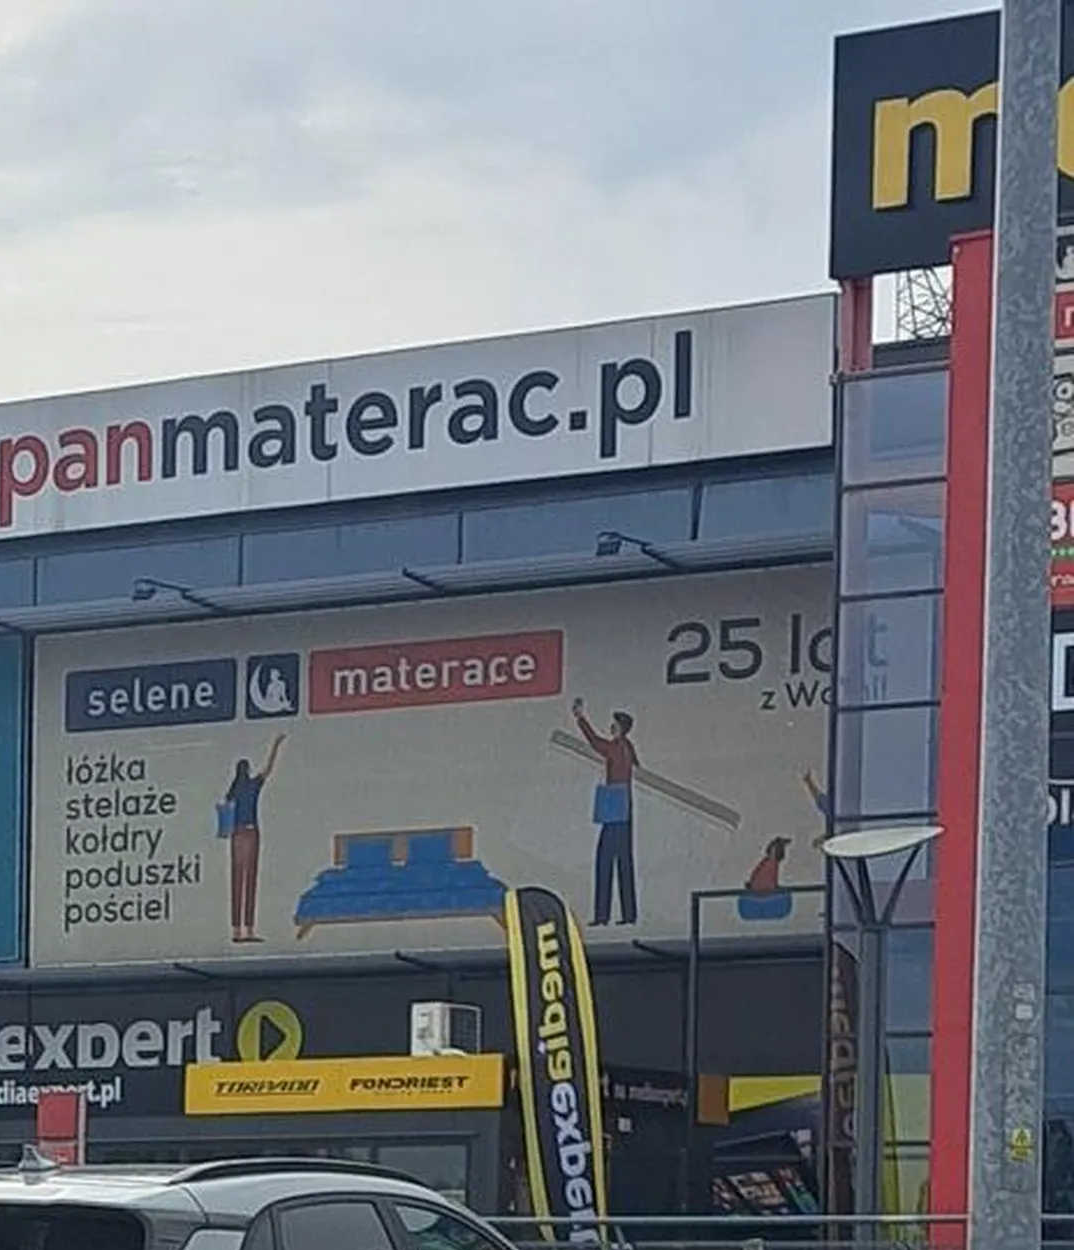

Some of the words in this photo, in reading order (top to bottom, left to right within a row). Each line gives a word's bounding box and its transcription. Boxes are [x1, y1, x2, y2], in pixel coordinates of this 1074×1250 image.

[666, 616, 764, 685] 25
[332, 653, 536, 698] materace
[86, 678, 216, 718] selene
[760, 690, 777, 711] z
[66, 752, 146, 785] łóżka
[66, 786, 177, 820] stelaże
[66, 823, 163, 860] kołdry
[65, 854, 201, 898] poduszki
[64, 888, 171, 933] pościel
[350, 1075, 470, 1091] FONDRIEST
